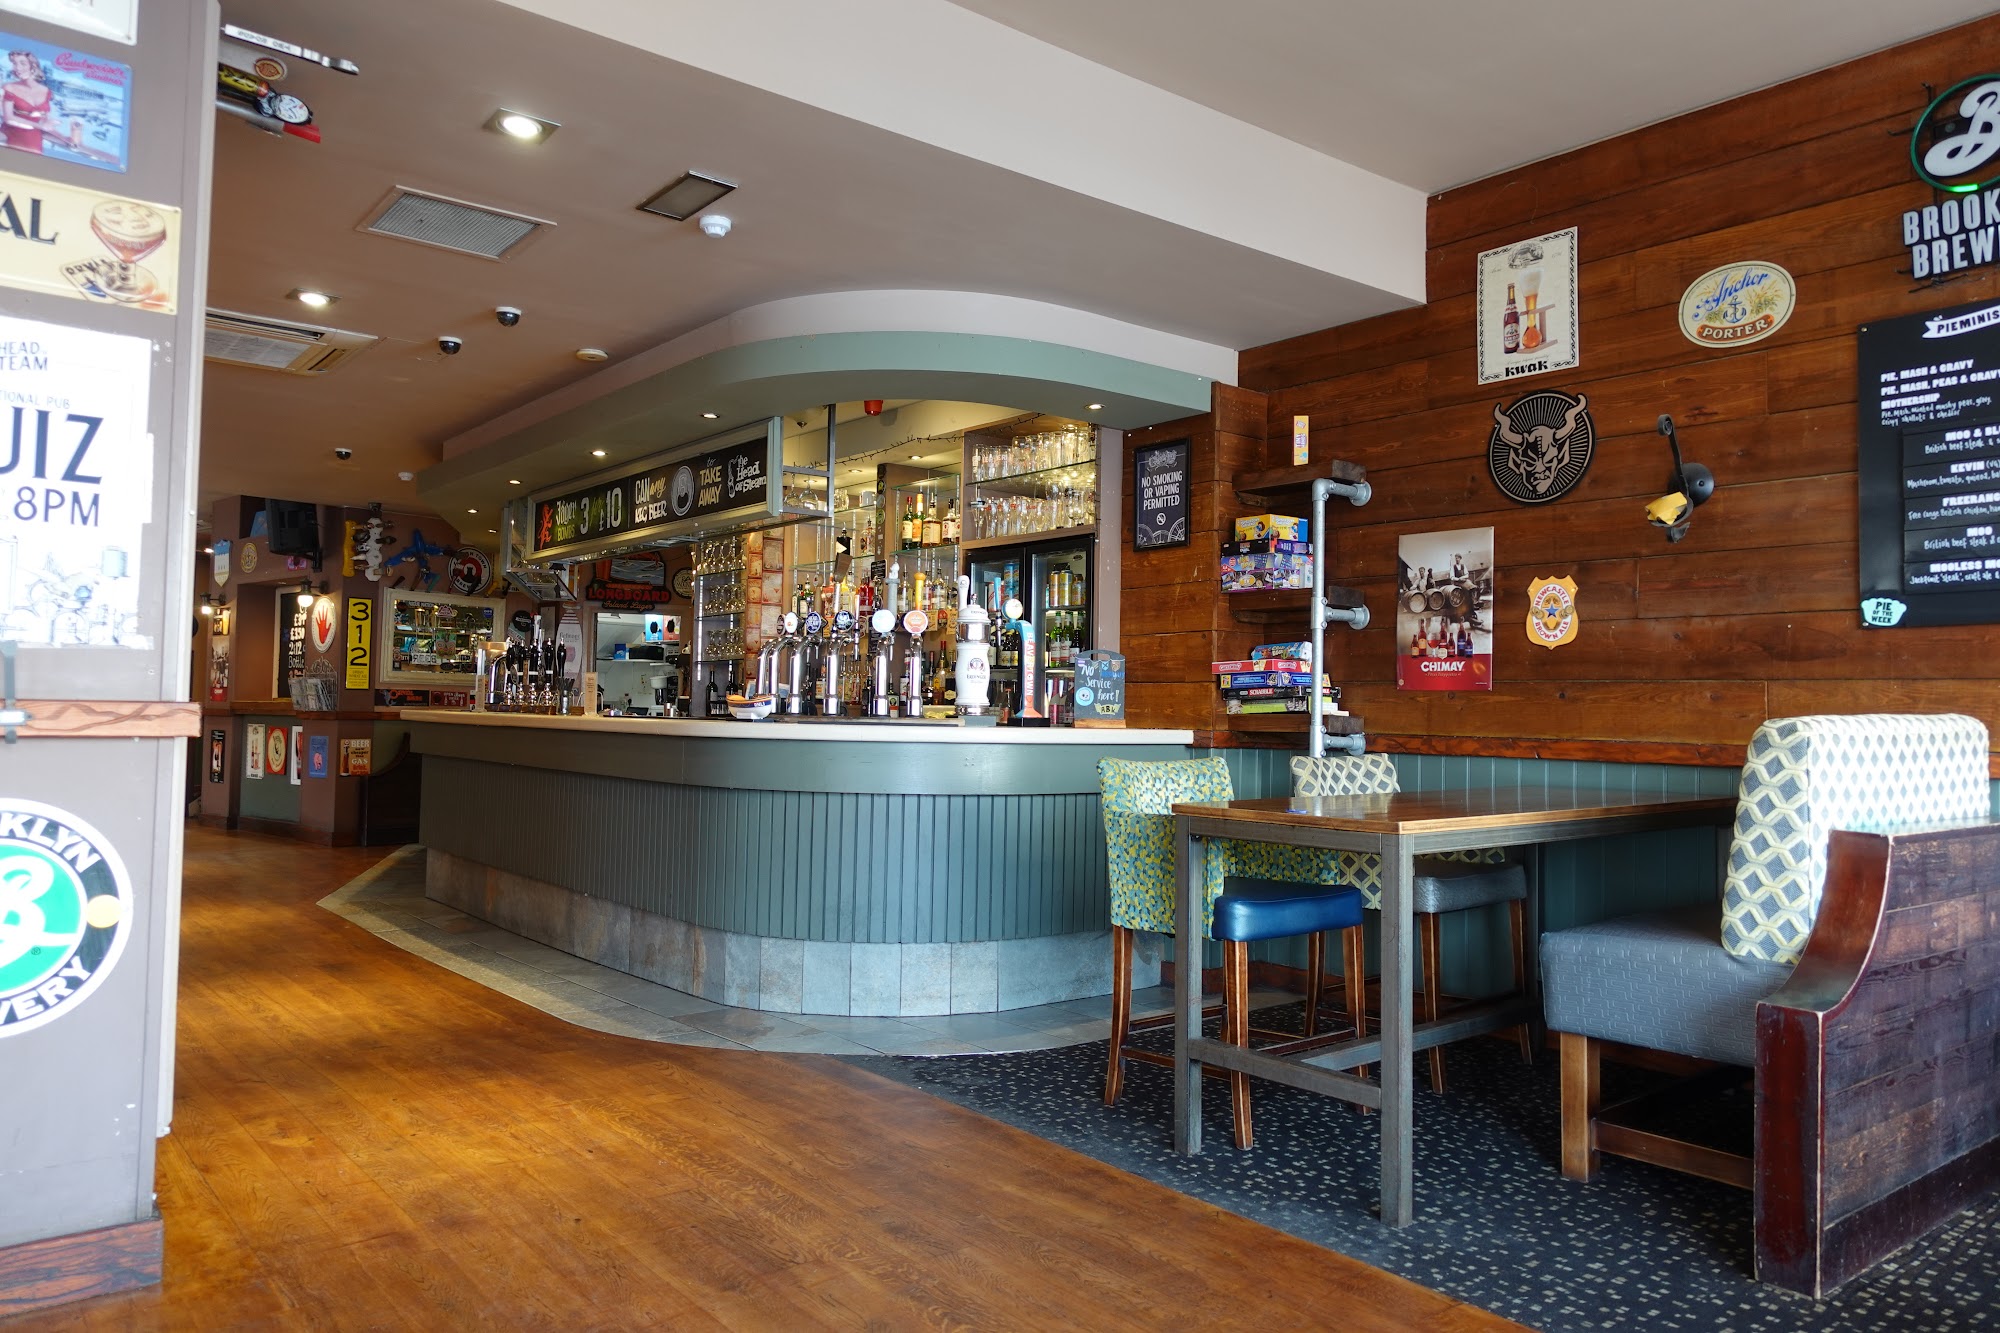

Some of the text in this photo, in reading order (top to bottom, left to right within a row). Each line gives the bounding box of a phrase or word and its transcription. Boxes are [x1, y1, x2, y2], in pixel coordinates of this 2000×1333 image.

[0, 192, 60, 245] AL
[1913, 225, 2000, 279] BREW
[1692, 267, 1769, 321] Anchor
[1702, 319, 1768, 339] PORTER
[1504, 360, 1549, 377] kwak
[1900, 366, 1929, 380] MASH
[1929, 365, 1938, 375] &
[1939, 359, 1974, 373] GRAVY
[1932, 376, 1958, 388] PEAS
[1959, 374, 1968, 384] &
[1881, 392, 1941, 410] MOTHERSHIP
[1945, 426, 2000, 441] MOO & BL
[736, 461, 760, 481] Head
[1950, 460, 1985, 473] KEVIN
[700, 466, 722, 486] TAKE
[742, 475, 767, 493] Steam
[1141, 470, 1183, 488] NO SMOKING
[635, 476, 667, 505] CAN any
[698, 484, 722, 508] AWAY
[1143, 482, 1180, 499] OR VAPING
[14, 486, 100, 527] 8PM
[1143, 494, 1180, 511] PERMITTED
[580, 497, 590, 535] 3
[635, 500, 668, 524] KEG BEER
[1966, 526, 1993, 537] MOO
[1924, 537, 1950, 550] British
[1929, 560, 1982, 573] MOOLESS
[588, 588, 670, 601] LONGBOARD
[1535, 586, 1569, 606] NEWCASTLE
[1875, 602, 1893, 611] PIE
[1871, 615, 1892, 624] WEEK
[1535, 621, 1569, 639] BROWN ALE
[1026, 632, 1035, 696] BEAVERTOWN
[1421, 660, 1466, 672] CHIMAY
[1085, 676, 1111, 688] Service
[351, 740, 369, 748] BEER
